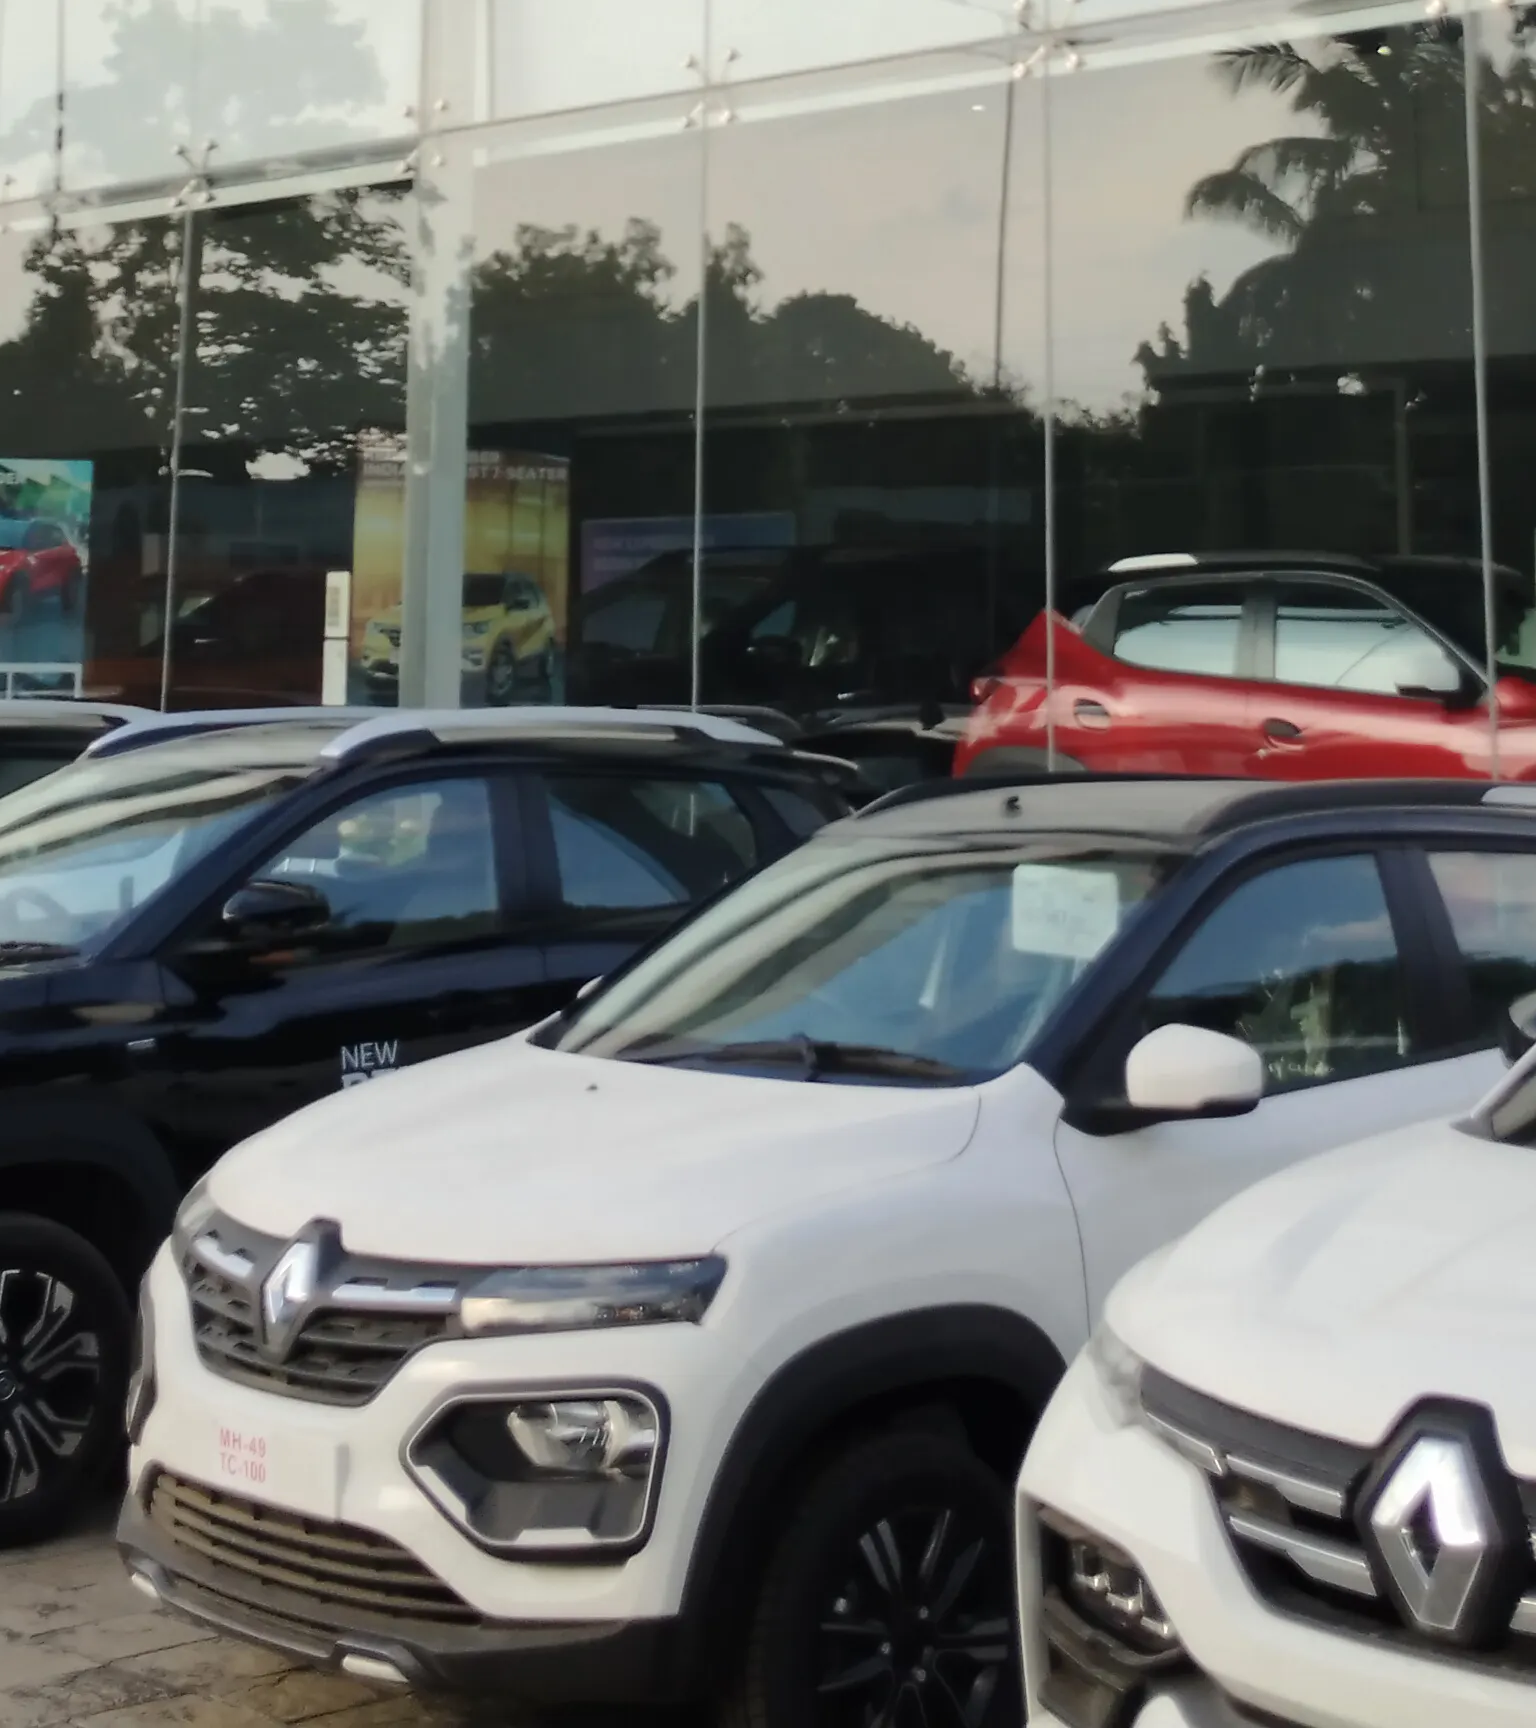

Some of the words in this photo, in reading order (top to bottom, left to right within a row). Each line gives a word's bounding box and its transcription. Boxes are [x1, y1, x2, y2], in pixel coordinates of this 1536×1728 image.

[341, 1040, 398, 1070] NEW
[219, 1427, 266, 1458] MH-49
[220, 1451, 266, 1483] TC-100
